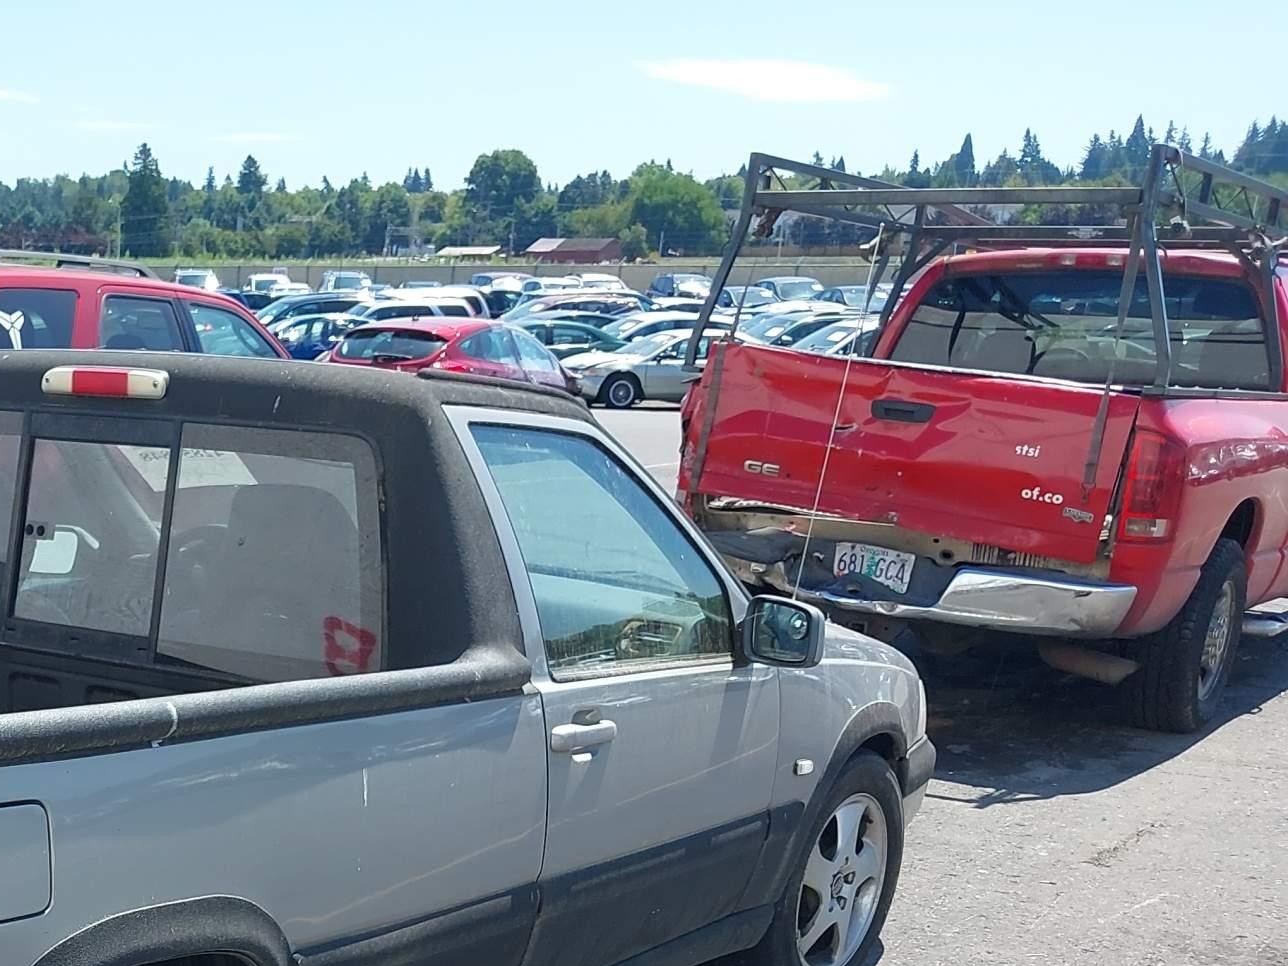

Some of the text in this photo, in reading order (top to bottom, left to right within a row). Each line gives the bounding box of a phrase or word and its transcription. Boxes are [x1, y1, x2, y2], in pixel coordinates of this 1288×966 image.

[1015, 444, 1041, 458] stsi
[743, 459, 781, 478] GE
[1020, 486, 1064, 505] of.co
[837, 551, 907, 584] 681 GCA
